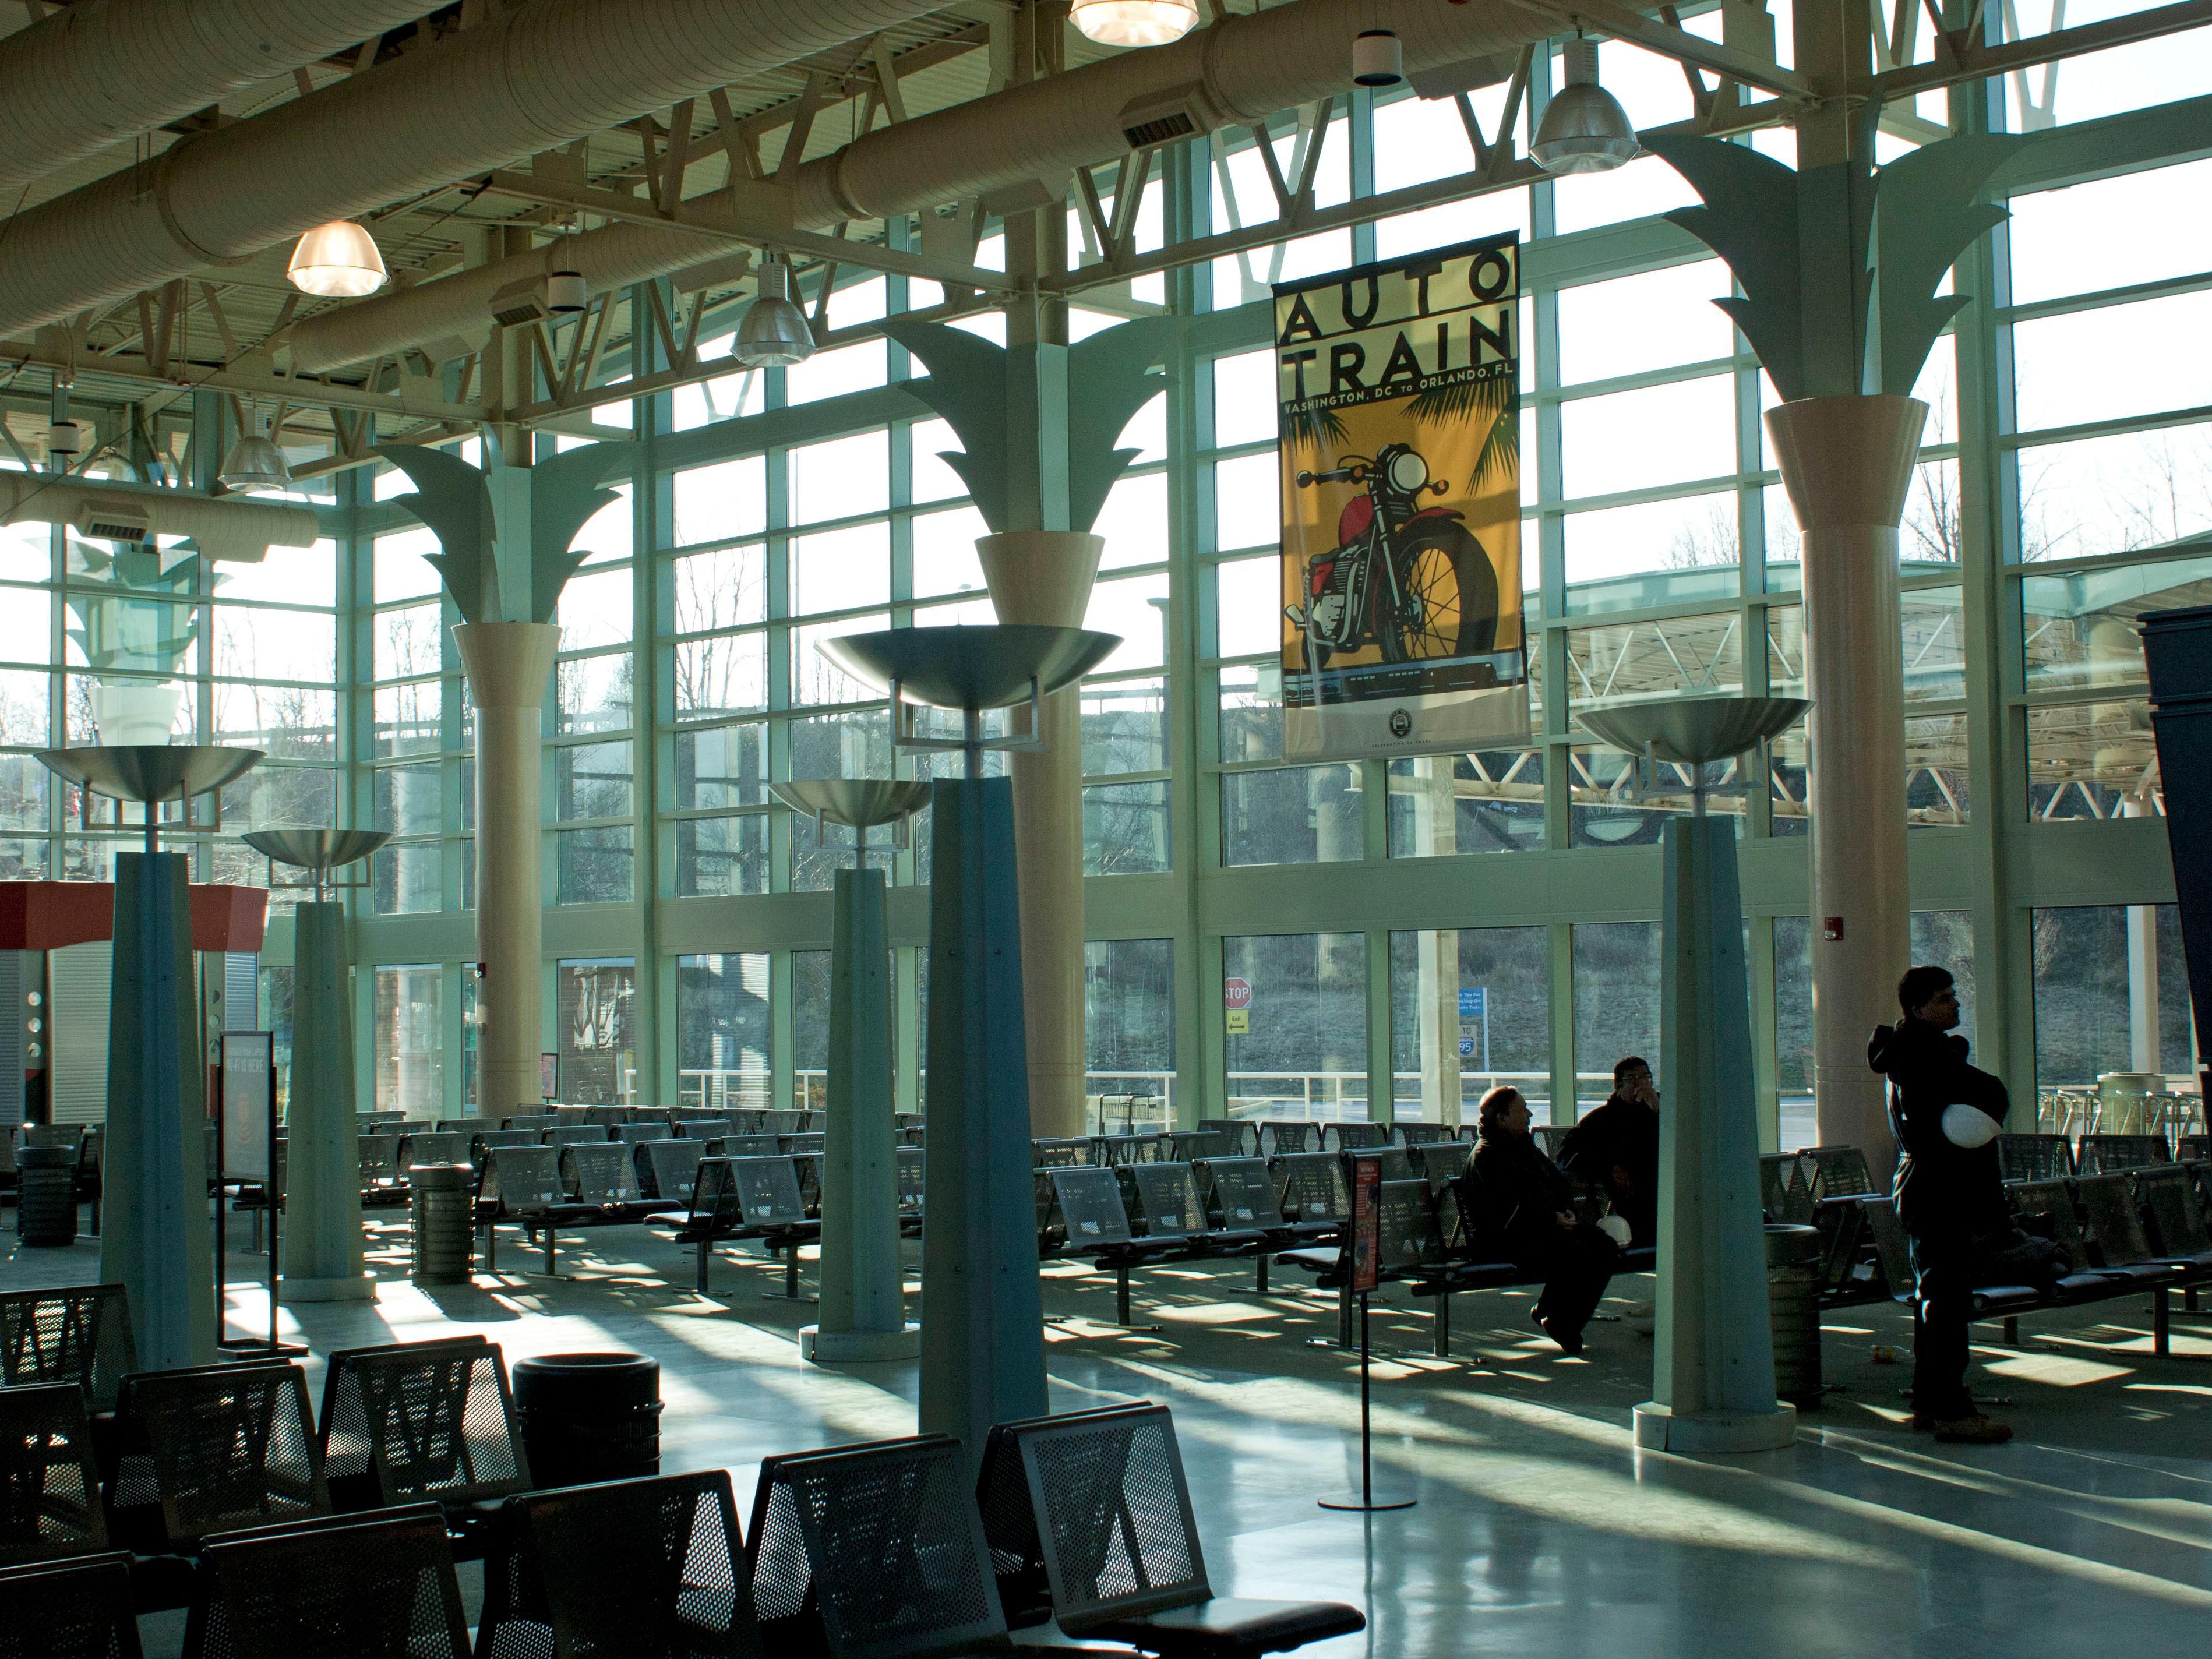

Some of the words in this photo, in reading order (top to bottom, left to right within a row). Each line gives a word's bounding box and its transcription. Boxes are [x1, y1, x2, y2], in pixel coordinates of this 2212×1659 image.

[1279, 250, 1510, 345] AUTO
[1281, 309, 1511, 402] TRAIN
[1375, 386, 1392, 397] DC
[1495, 363, 1513, 375] FL
[1459, 1043, 1472, 1052] 95
[1462, 1026, 1471, 1035] TO
